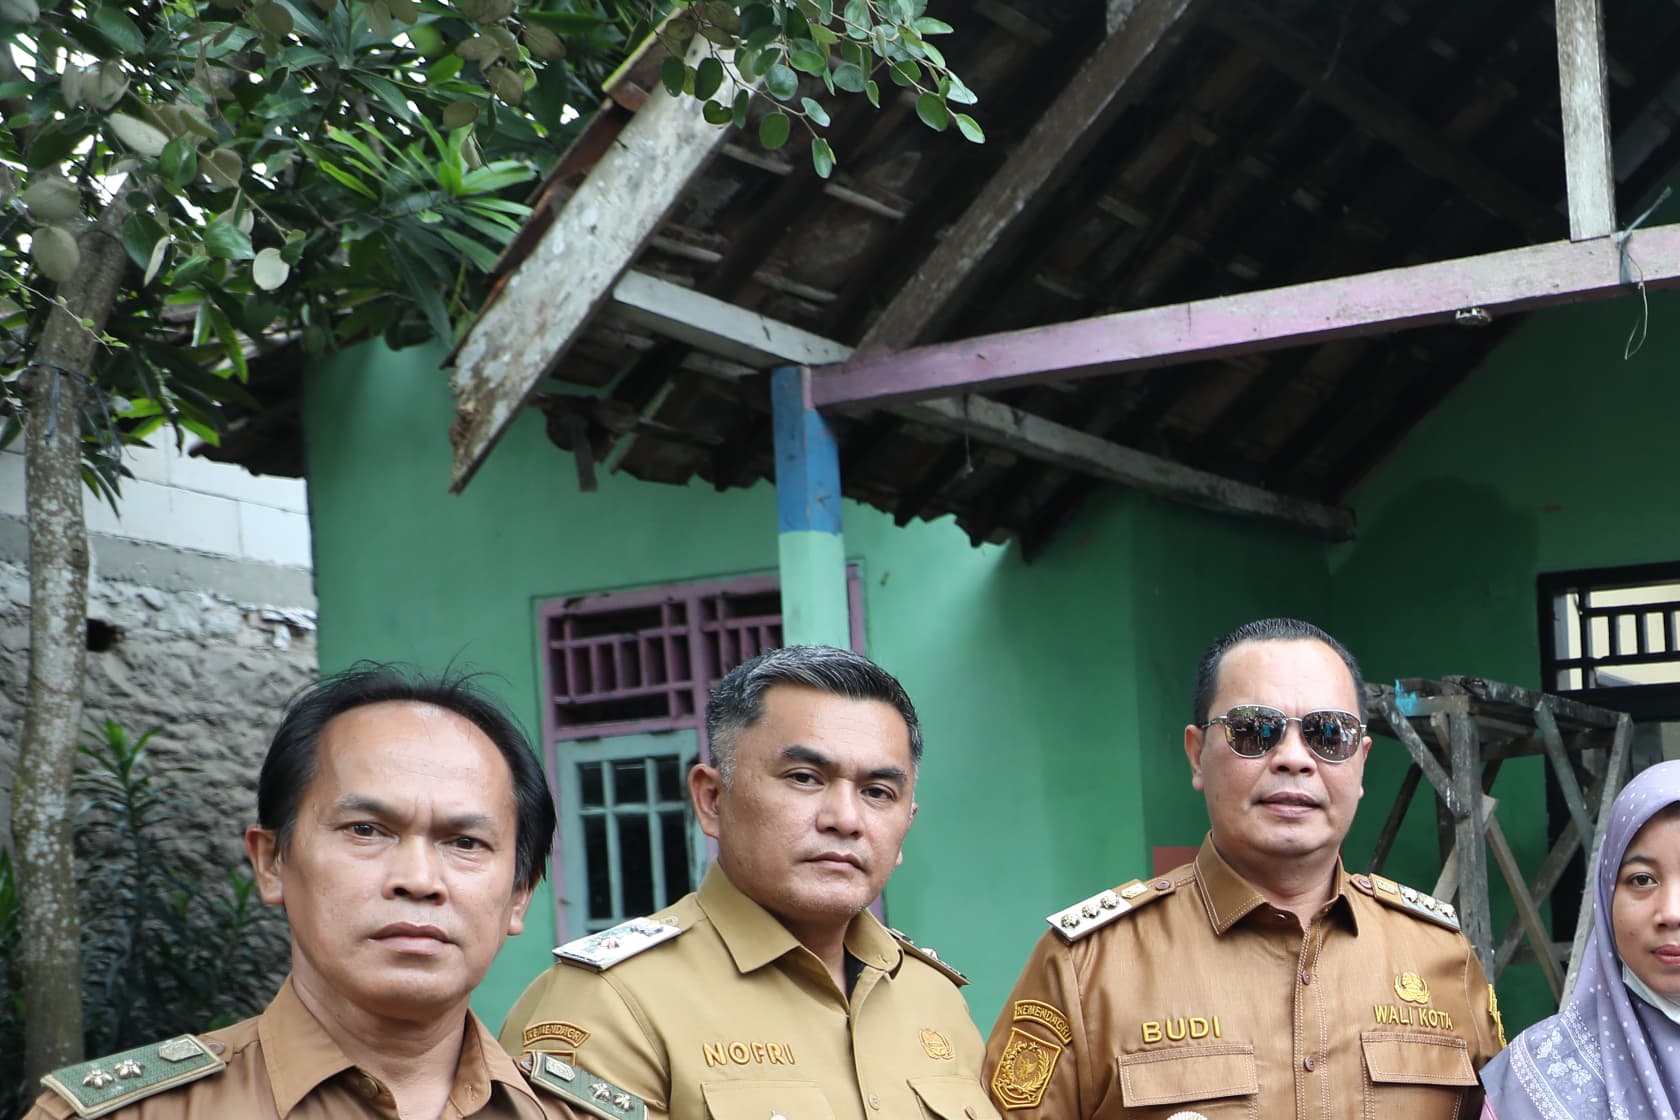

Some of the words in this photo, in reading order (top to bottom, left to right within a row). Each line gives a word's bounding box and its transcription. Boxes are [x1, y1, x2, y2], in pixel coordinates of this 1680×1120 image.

[1016, 1004, 1071, 1039] KEMENDAGRI
[1142, 1015, 1222, 1043] BUDI
[1374, 1004, 1413, 1026] WALI
[1418, 1008, 1454, 1031] KOTA
[527, 1024, 584, 1042] KEMENDAGRI
[703, 1041, 795, 1068] NOFRI
